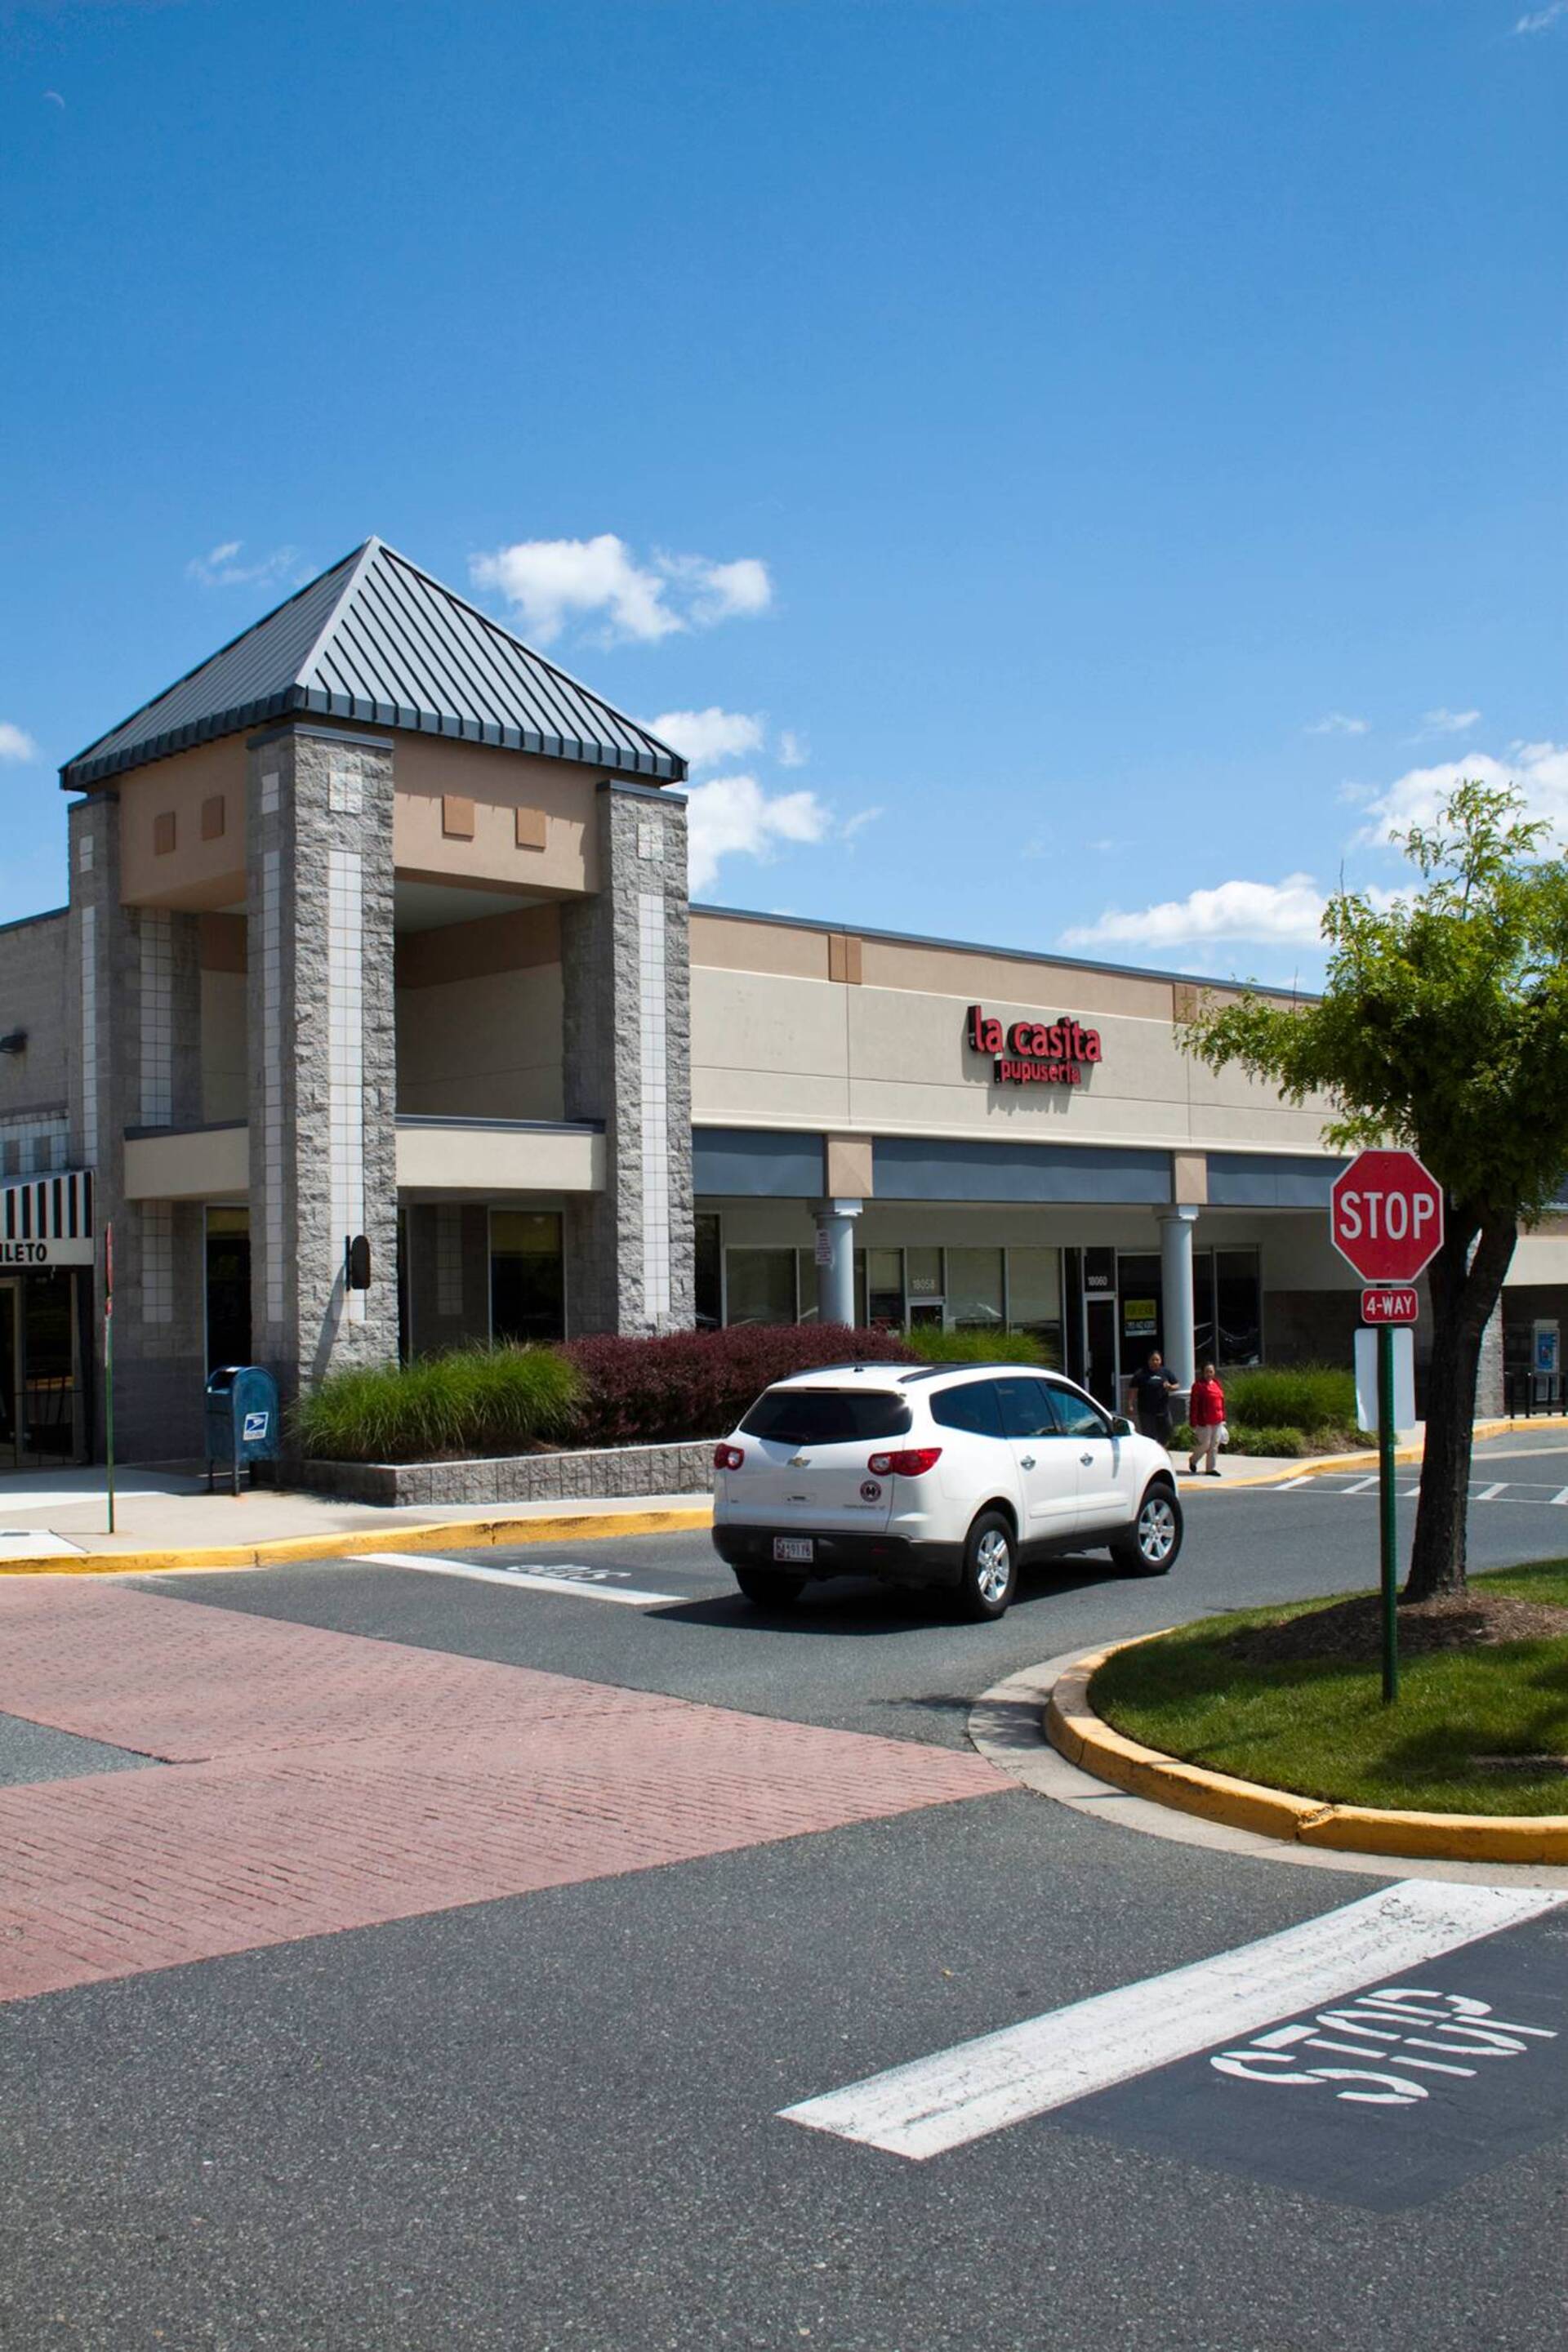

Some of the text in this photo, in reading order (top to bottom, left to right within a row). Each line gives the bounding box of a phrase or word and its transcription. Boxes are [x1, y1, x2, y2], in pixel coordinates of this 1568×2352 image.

[968, 1005, 1102, 1062] la casita
[1339, 1191, 1435, 1240] STOP
[1365, 1295, 1412, 1316] 4-WAY
[1210, 1988, 1559, 2105] STOP
